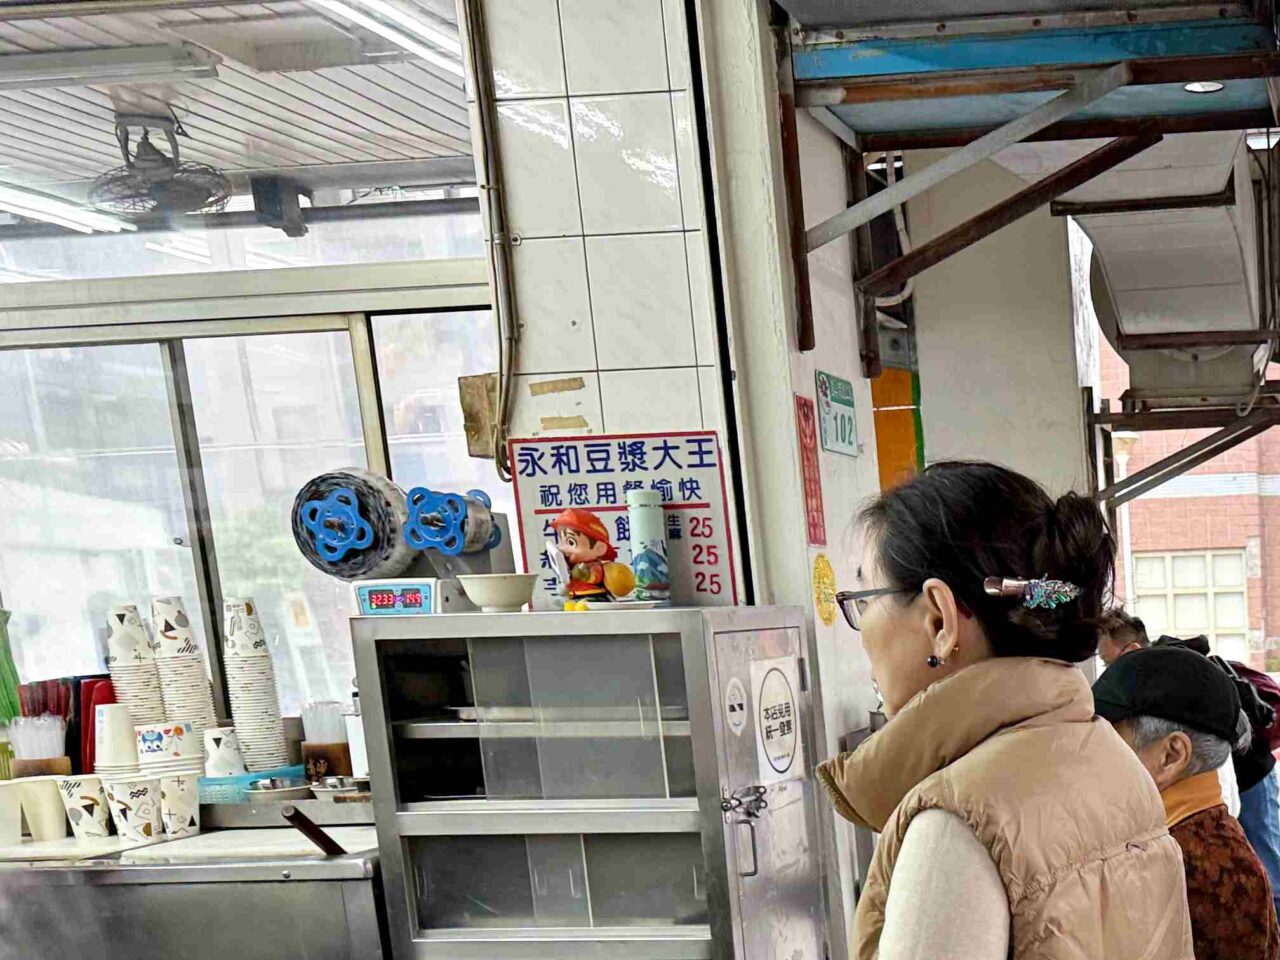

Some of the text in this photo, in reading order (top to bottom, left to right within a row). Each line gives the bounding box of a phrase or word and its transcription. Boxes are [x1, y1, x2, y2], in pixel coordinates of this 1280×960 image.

[833, 411, 854, 446] 102
[517, 437, 717, 478] 永和豆漿大王
[689, 517, 713, 538] 25
[692, 545, 719, 566] 25
[695, 572, 721, 595] 25
